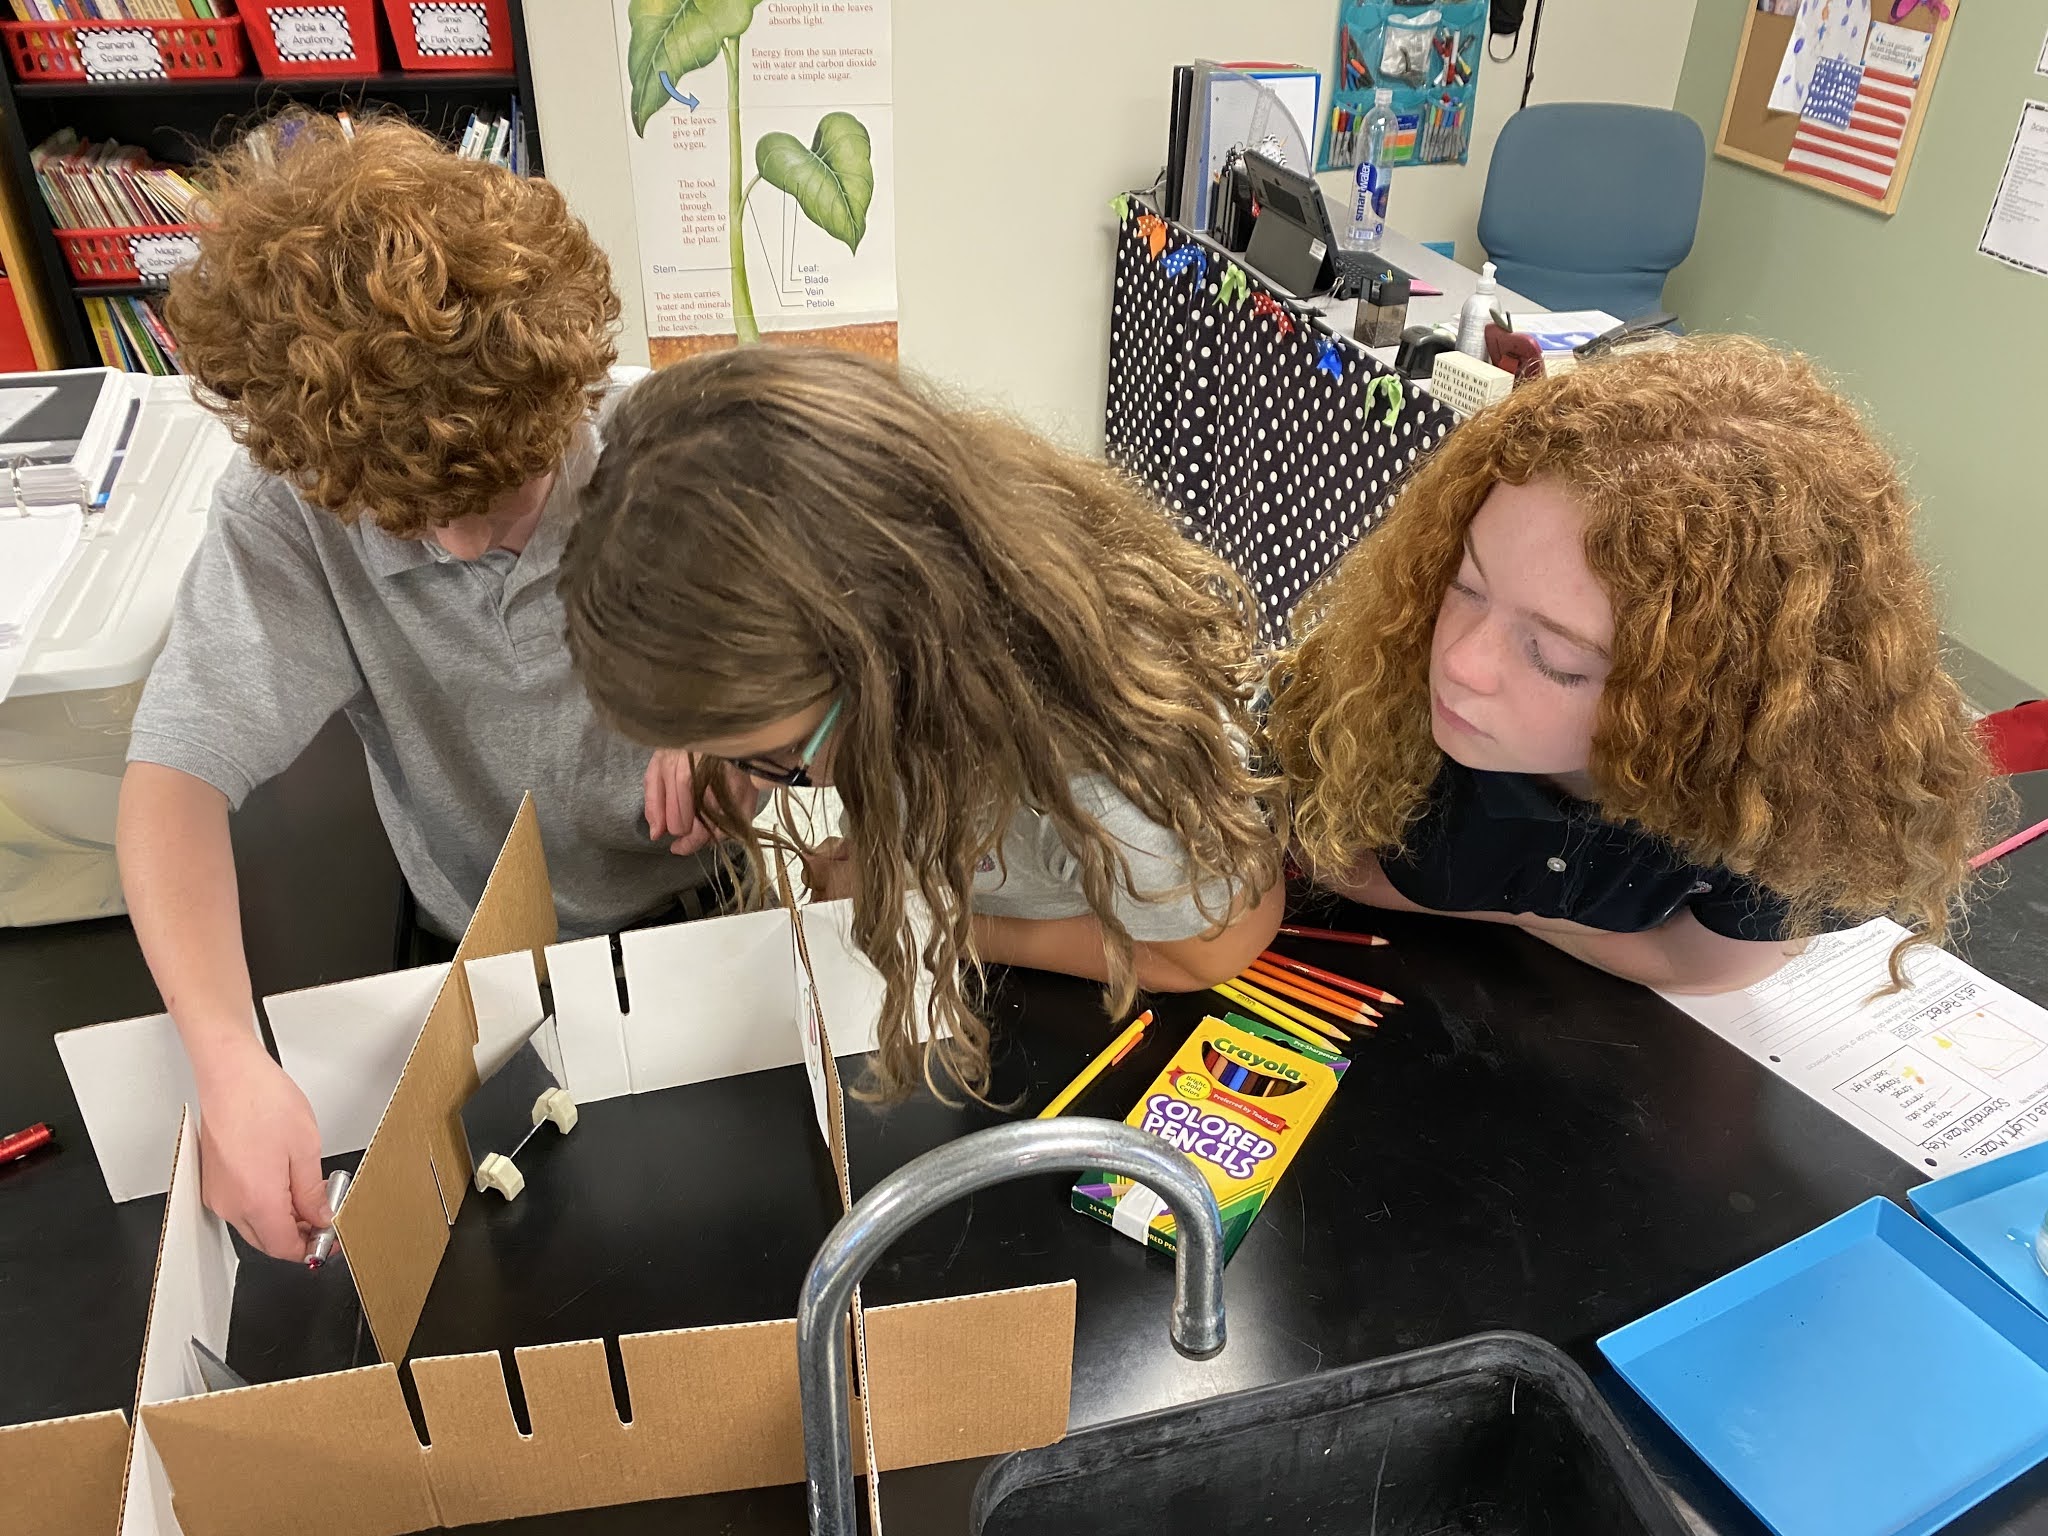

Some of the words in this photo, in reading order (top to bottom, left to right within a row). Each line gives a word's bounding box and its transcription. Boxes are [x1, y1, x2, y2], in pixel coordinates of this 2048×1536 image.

[768, 3, 819, 15] Chlorophyll
[821, 3, 830, 12] in
[832, 3, 845, 12] the
[847, 3, 873, 12] leaves
[768, 16, 801, 25] absorbs
[803, 16, 824, 27] light.
[294, 23, 316, 32] Bible
[318, 23, 326, 32] &
[96, 40, 135, 50] General
[292, 35, 334, 45] Anatomy
[430, 35, 451, 44] Flash
[452, 35, 475, 44] Cards
[100, 53, 138, 63] Science
[751, 48, 781, 58] Energy
[784, 48, 804, 57] from
[806, 47, 820, 56] the
[839, 48, 873, 56] interacts
[752, 60, 771, 70] with
[773, 61, 797, 69] water
[799, 59, 814, 68] and
[816, 59, 844, 68] carbon
[846, 59, 877, 67] dioxide
[753, 73, 762, 81] to
[763, 73, 788, 81] create
[798, 71, 826, 82] simple
[827, 72, 852, 82] sugar.
[670, 116, 688, 125] The
[690, 115, 717, 125] leaves
[672, 129, 691, 139] give
[692, 127, 706, 137] off
[673, 141, 706, 151] oxygen.
[677, 179, 694, 188] The
[697, 179, 716, 188] food
[679, 191, 707, 200] travels
[1356, 163, 1371, 221] smartwater
[680, 201, 712, 212] through
[681, 213, 694, 222] the
[696, 212, 716, 222] stem
[718, 213, 726, 221] to
[682, 224, 693, 234] all
[695, 224, 715, 235] parts
[717, 223, 726, 232] of
[683, 236, 696, 245] the
[698, 235, 721, 246] plant.
[154, 247, 182, 256] Magic
[652, 264, 677, 274] Stem
[798, 264, 820, 273] Leaf:
[804, 275, 829, 284] Blade
[654, 291, 670, 300] The
[693, 290, 721, 298] carries
[805, 287, 824, 296] Vein
[656, 303, 678, 311] water
[680, 301, 695, 310] and
[697, 299, 731, 309] minerals
[806, 299, 835, 308] Petiole
[657, 314, 677, 323] from
[679, 312, 691, 321] the
[693, 313, 713, 321] roots
[658, 324, 670, 332] the
[672, 323, 700, 332] leaves.
[1436, 360, 1470, 380] TEACHERS
[1473, 378, 1488, 388] WHO
[1433, 379, 1452, 392] TEACH
[1434, 369, 1450, 381] LOVE
[1453, 378, 1485, 397] TEACHING
[1432, 388, 1439, 396] TO
[1440, 391, 1453, 402] LOVE
[1959, 983, 1987, 1001] Let's
[1293, 1040, 1339, 1061] Pre-Sharpened
[1213, 1037, 1301, 1081] Crayola
[1180, 1084, 1200, 1098] Colors
[1186, 1081, 1202, 1092] Bold
[1213, 1093, 1244, 1110] Preferred
[1242, 1104, 1252, 1114] by
[1252, 1110, 1280, 1129] Teachers!
[1942, 1097, 2011, 1141] Schematic/Maze
[2025, 1113, 2039, 1122] a
[1148, 1095, 1275, 1159] COLORED
[2001, 1117, 2037, 1140] Light
[1142, 1112, 1256, 1178] PENCILS
[1922, 1137, 1951, 1153] Key
[1089, 1203, 1098, 1212] 24
